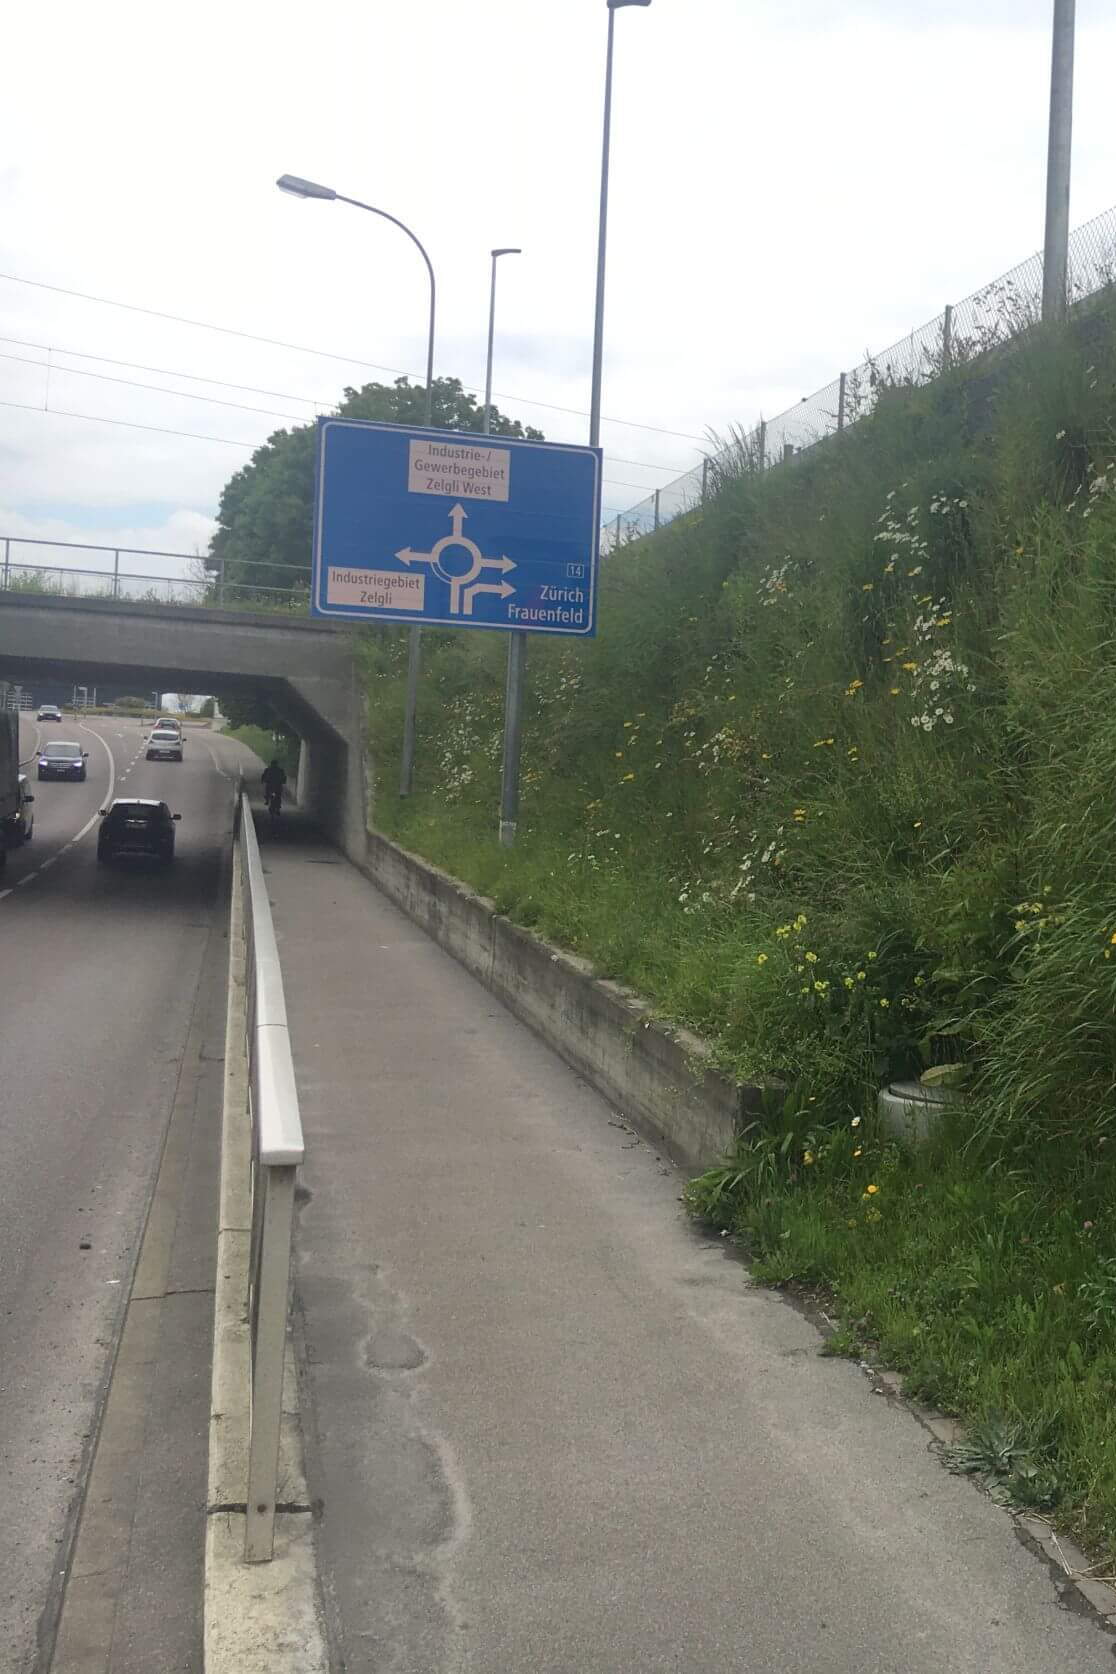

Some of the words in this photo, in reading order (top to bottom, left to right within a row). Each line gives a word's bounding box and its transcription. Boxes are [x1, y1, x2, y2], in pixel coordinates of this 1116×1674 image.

[414, 459, 505, 480] Gewerbegebiet
[426, 478, 459, 494] Zelgli
[463, 482, 491, 496] West
[332, 571, 420, 589] Industriegebiet
[570, 566, 582, 577] 14
[360, 590, 392, 606] Zelgli
[540, 585, 584, 603] Zürich
[508, 604, 583, 624] Frauenfeld
